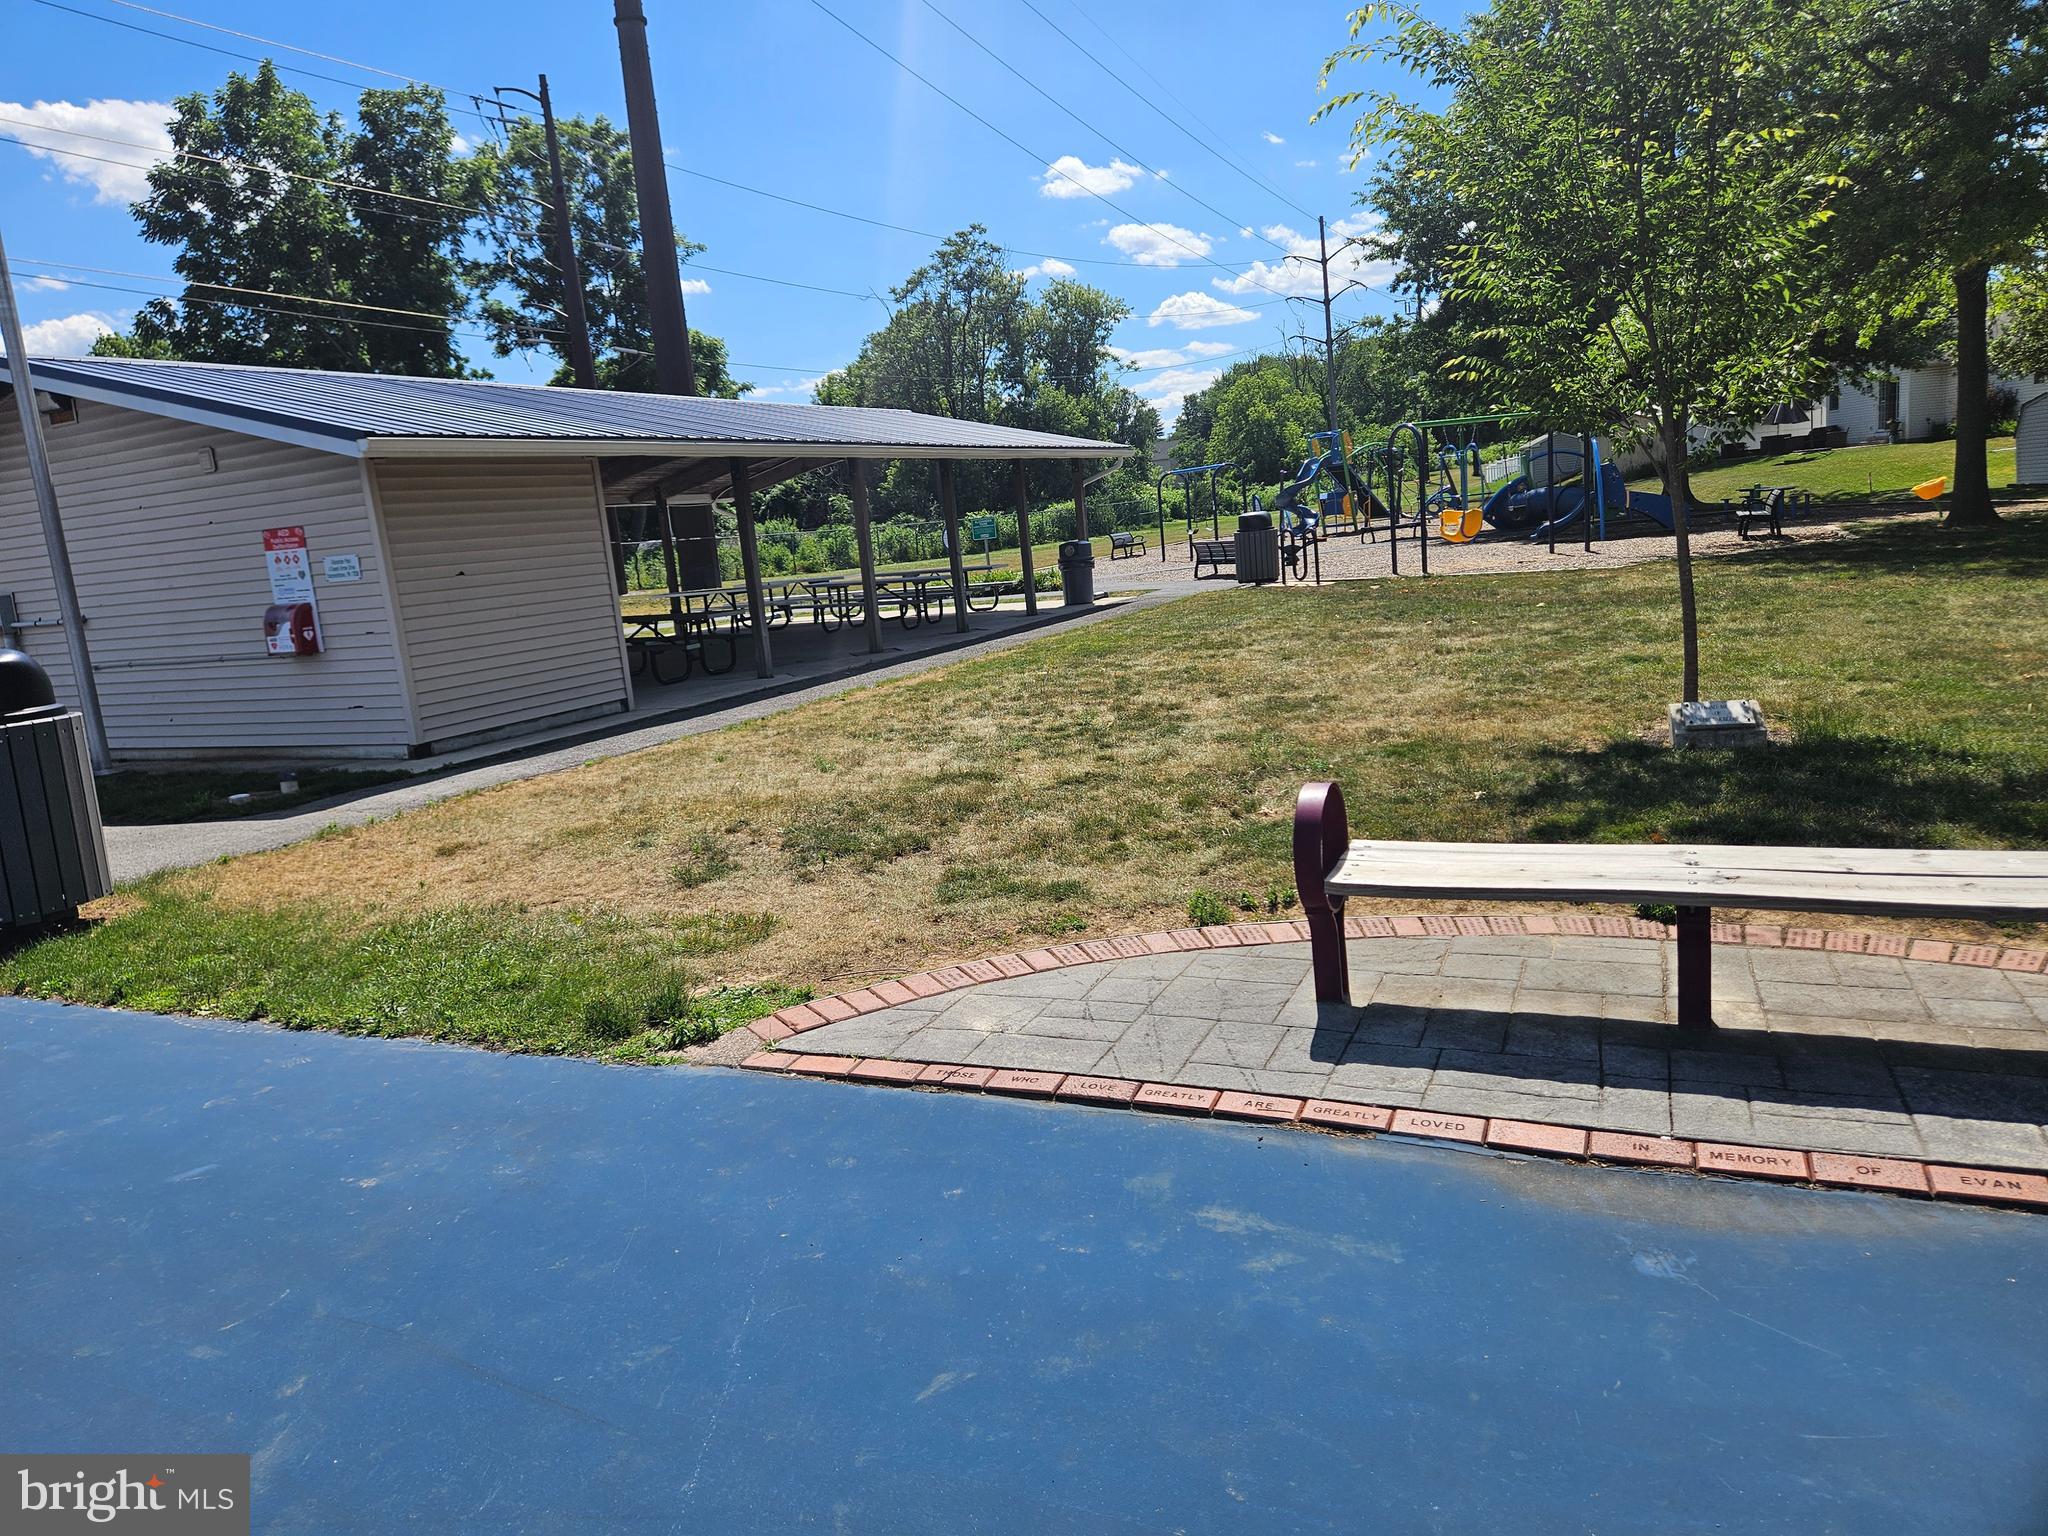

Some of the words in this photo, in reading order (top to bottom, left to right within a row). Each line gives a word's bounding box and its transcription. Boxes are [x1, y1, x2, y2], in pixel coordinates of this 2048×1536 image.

[936, 1069, 975, 1079] THOSE
[1011, 1075, 1040, 1084] WHO
[1080, 1081, 1117, 1091] LOVE
[1244, 1099, 1274, 1110] ARE
[1313, 1106, 1380, 1121] GREATLY
[1410, 1118, 1466, 1131] LOVED
[1632, 1142, 1650, 1151] IN
[1709, 1150, 1792, 1167] MEMORY
[1856, 1165, 1882, 1176] OF
[1960, 1175, 2023, 1190] EVAN
